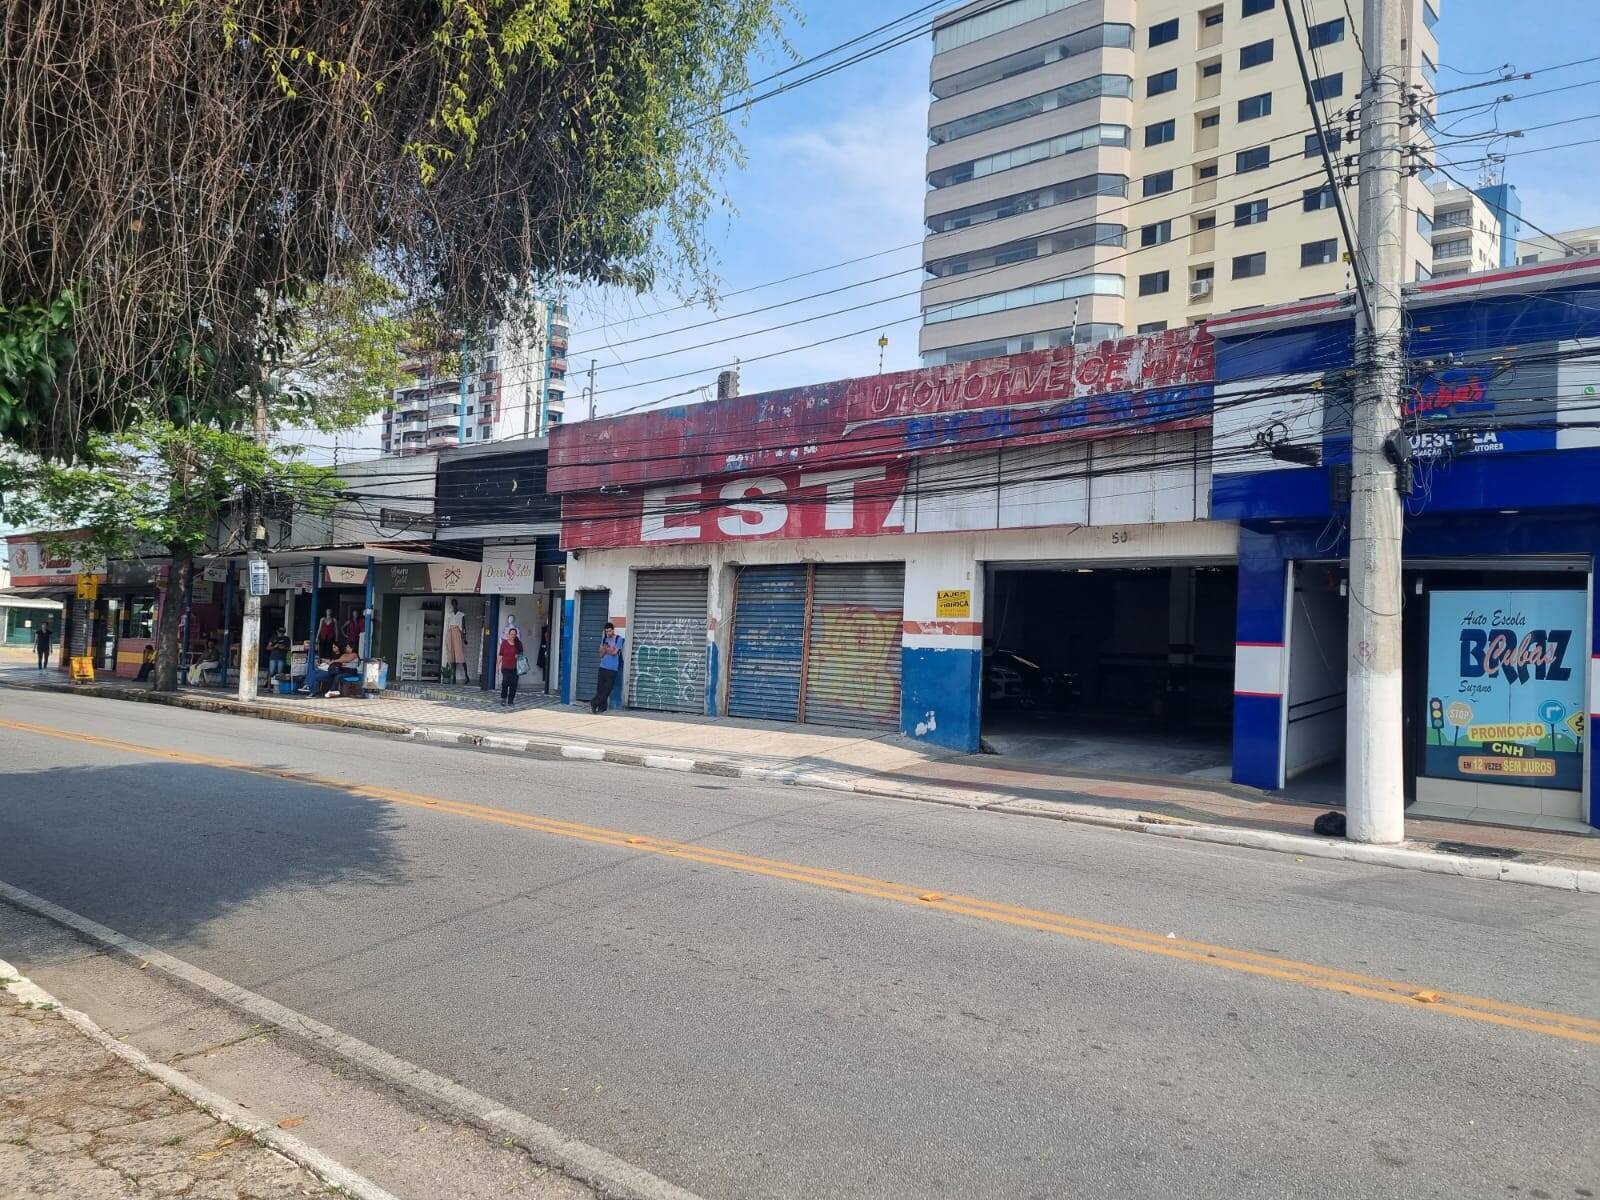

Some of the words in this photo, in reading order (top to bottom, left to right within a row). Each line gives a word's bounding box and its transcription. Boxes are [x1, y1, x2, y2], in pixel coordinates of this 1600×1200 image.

[1461, 611, 1488, 626] Auto
[1492, 609, 1527, 627] Escola
[1459, 628, 1573, 686] BRAZ
[1484, 633, 1557, 675] Cubas
[1458, 680, 1492, 697] Suzano
[1449, 709, 1470, 719] STOP
[1471, 722, 1544, 740] PROMOÇÃO
[1492, 742, 1524, 757] CNH
[1463, 761, 1472, 770] EM
[1473, 759, 1483, 771] 12
[1484, 762, 1502, 771] VEZES
[1503, 759, 1522, 773] SEM
[1523, 761, 1552, 774] JUROS
